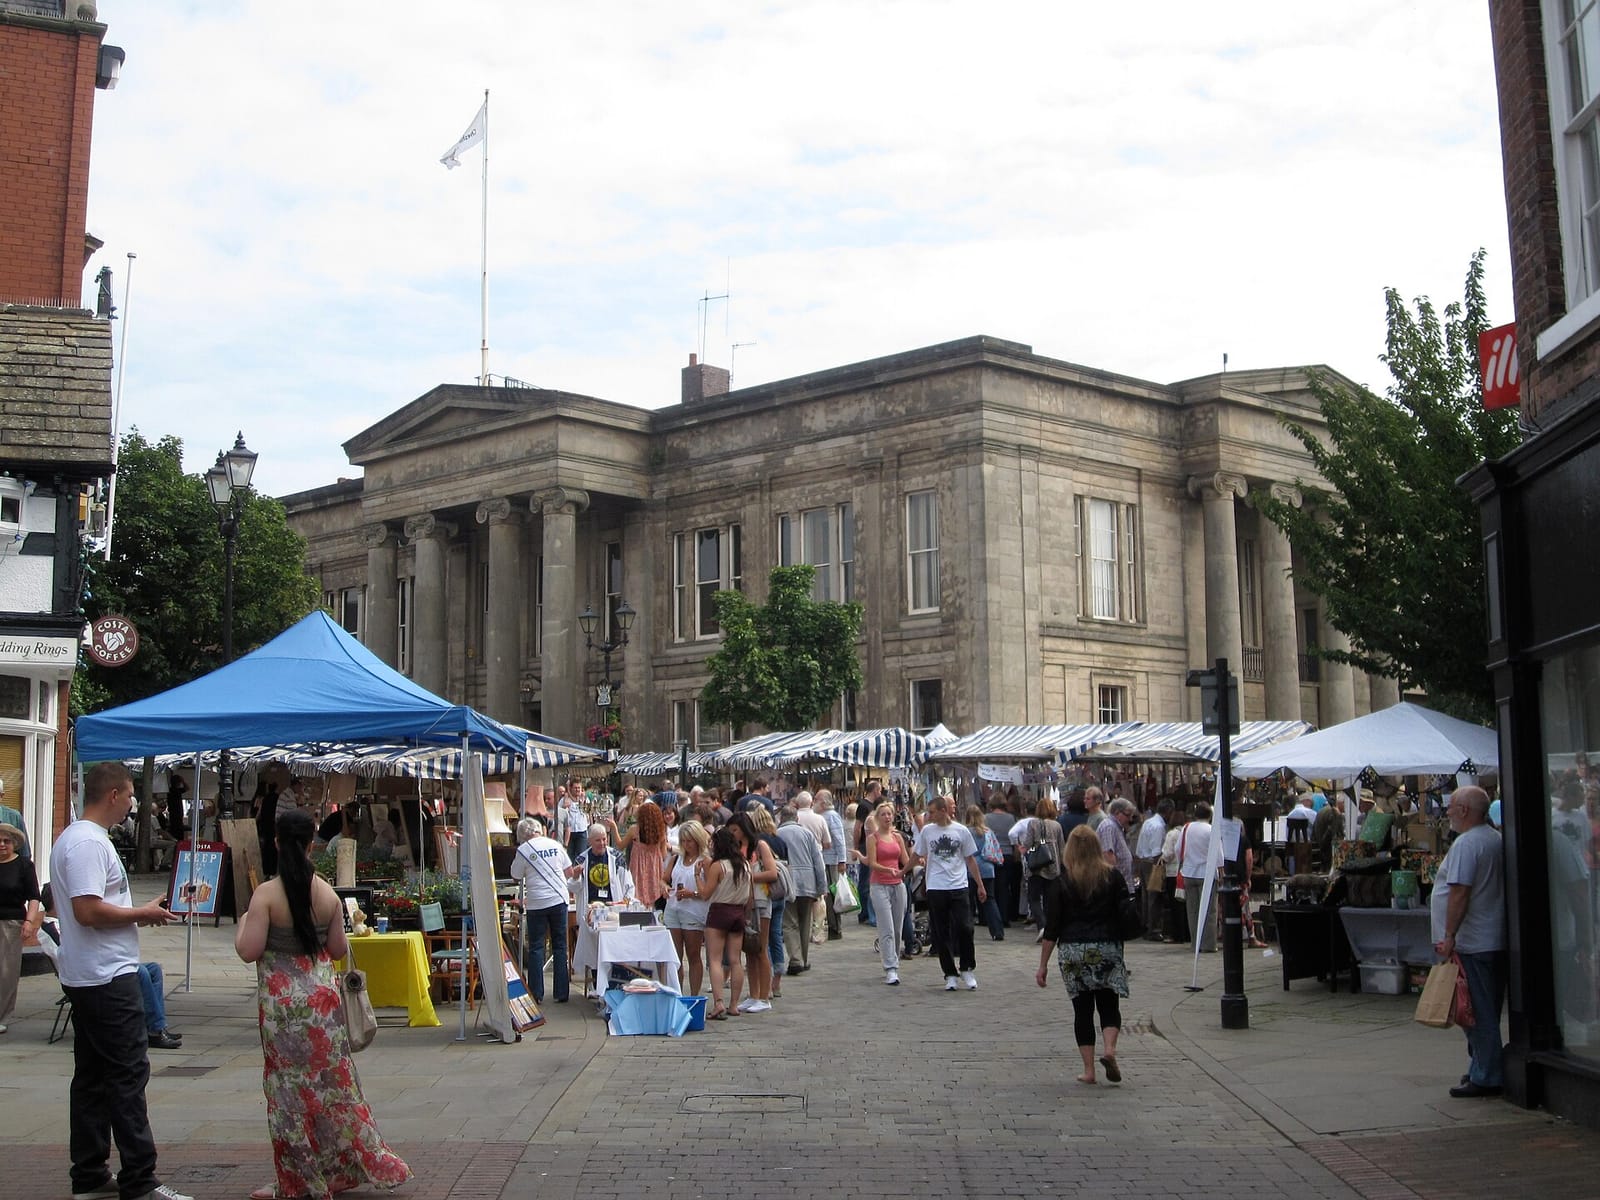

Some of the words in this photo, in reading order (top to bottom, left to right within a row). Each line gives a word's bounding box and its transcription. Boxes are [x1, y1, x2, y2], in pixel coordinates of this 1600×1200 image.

[1485, 333, 1519, 392] ill
[97, 620, 129, 634] COSTA
[33, 641, 69, 658] Rings
[94, 644, 132, 661] COFFEE
[183, 852, 217, 863] KEEP
[537, 848, 559, 858] TAFF
